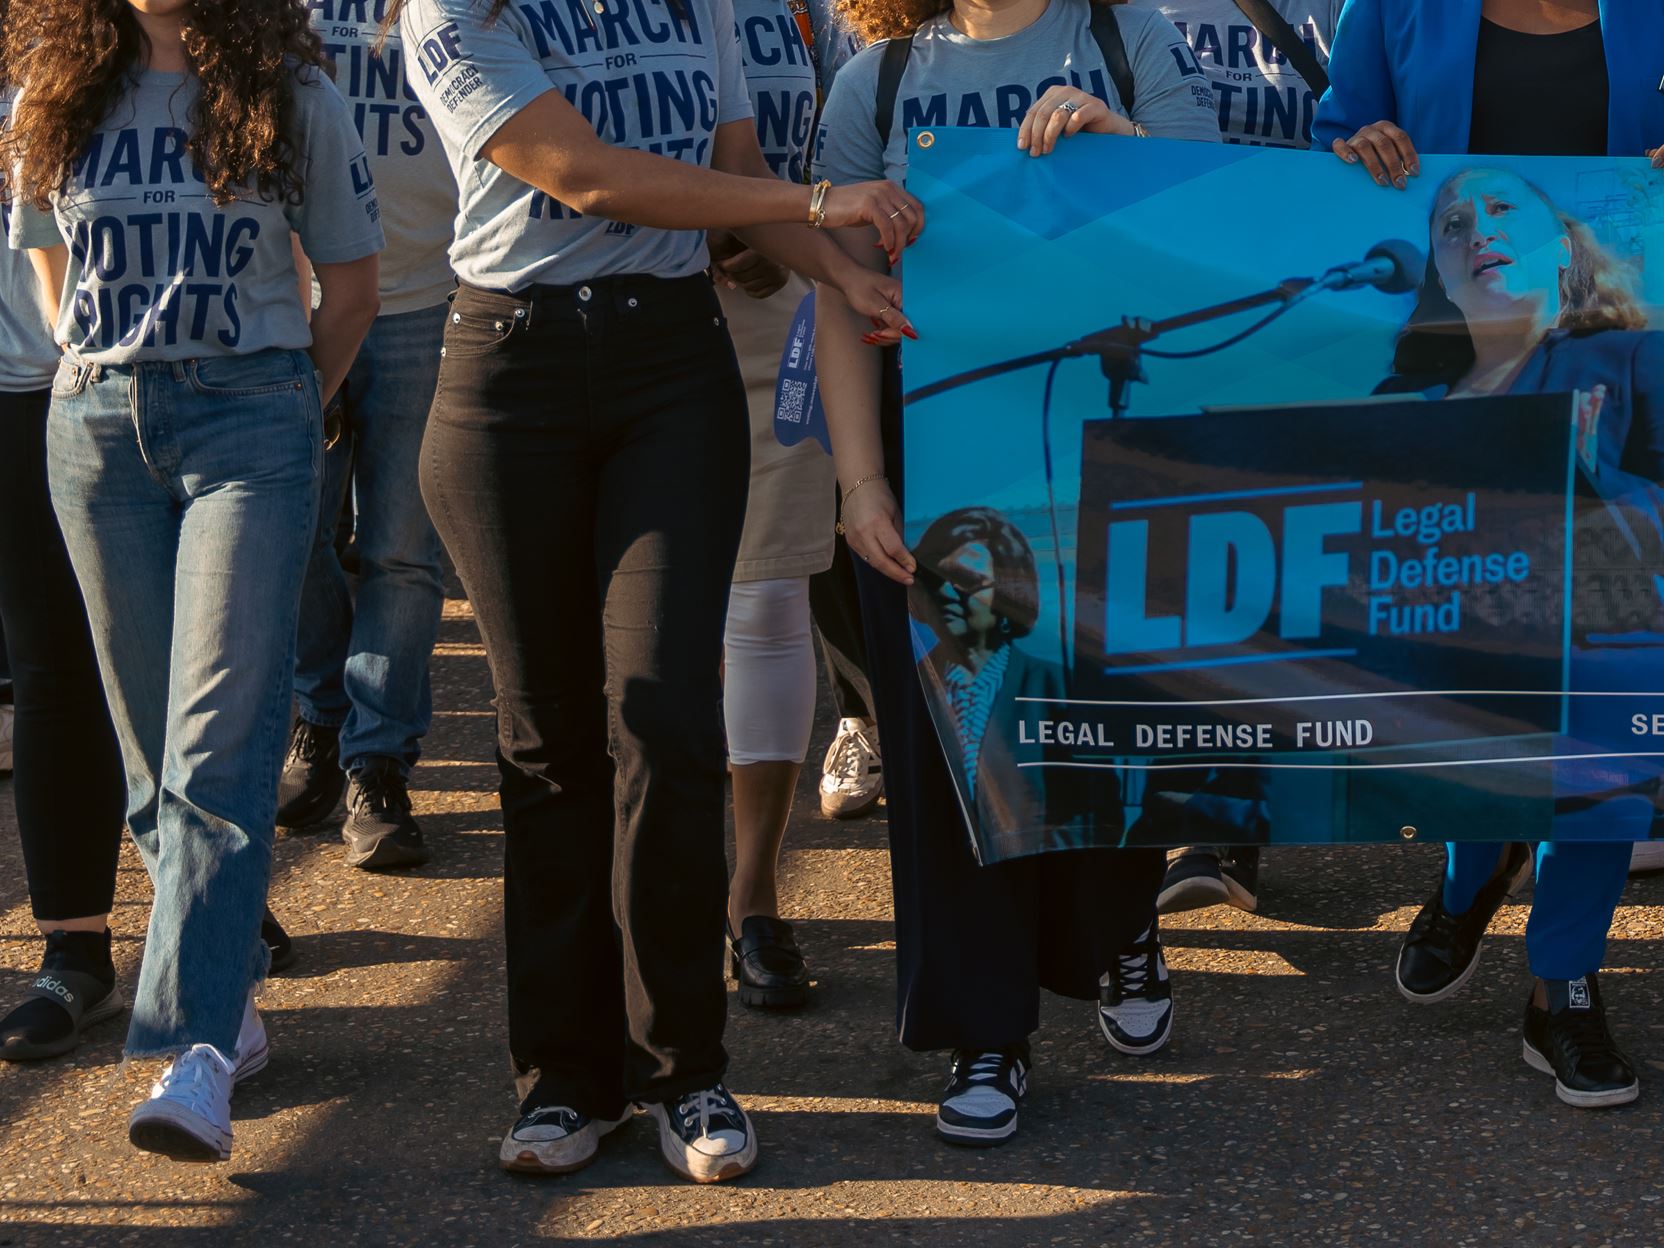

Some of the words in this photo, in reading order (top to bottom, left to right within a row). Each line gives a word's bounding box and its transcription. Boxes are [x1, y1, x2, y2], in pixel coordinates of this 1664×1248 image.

[332, 26, 359, 38] FOR
[417, 22, 462, 86] LDF
[605, 53, 638, 70] FOR
[440, 64, 479, 106] DEMOCRACY
[446, 76, 483, 114] DEFENDER
[1226, 71, 1252, 82] FOR
[143, 189, 175, 204] FOR
[66, 211, 260, 285] VOTING
[73, 282, 242, 349] RIGHTS
[788, 337, 803, 368] LDF
[1105, 501, 1363, 654] LDF
[1372, 492, 1476, 545] Legal
[1369, 549, 1531, 592] Defense
[1369, 593, 1462, 636] Fund
[1018, 719, 1115, 748] LEGAL
[1135, 721, 1275, 750] DEFENSE
[1297, 718, 1375, 748] FUND
